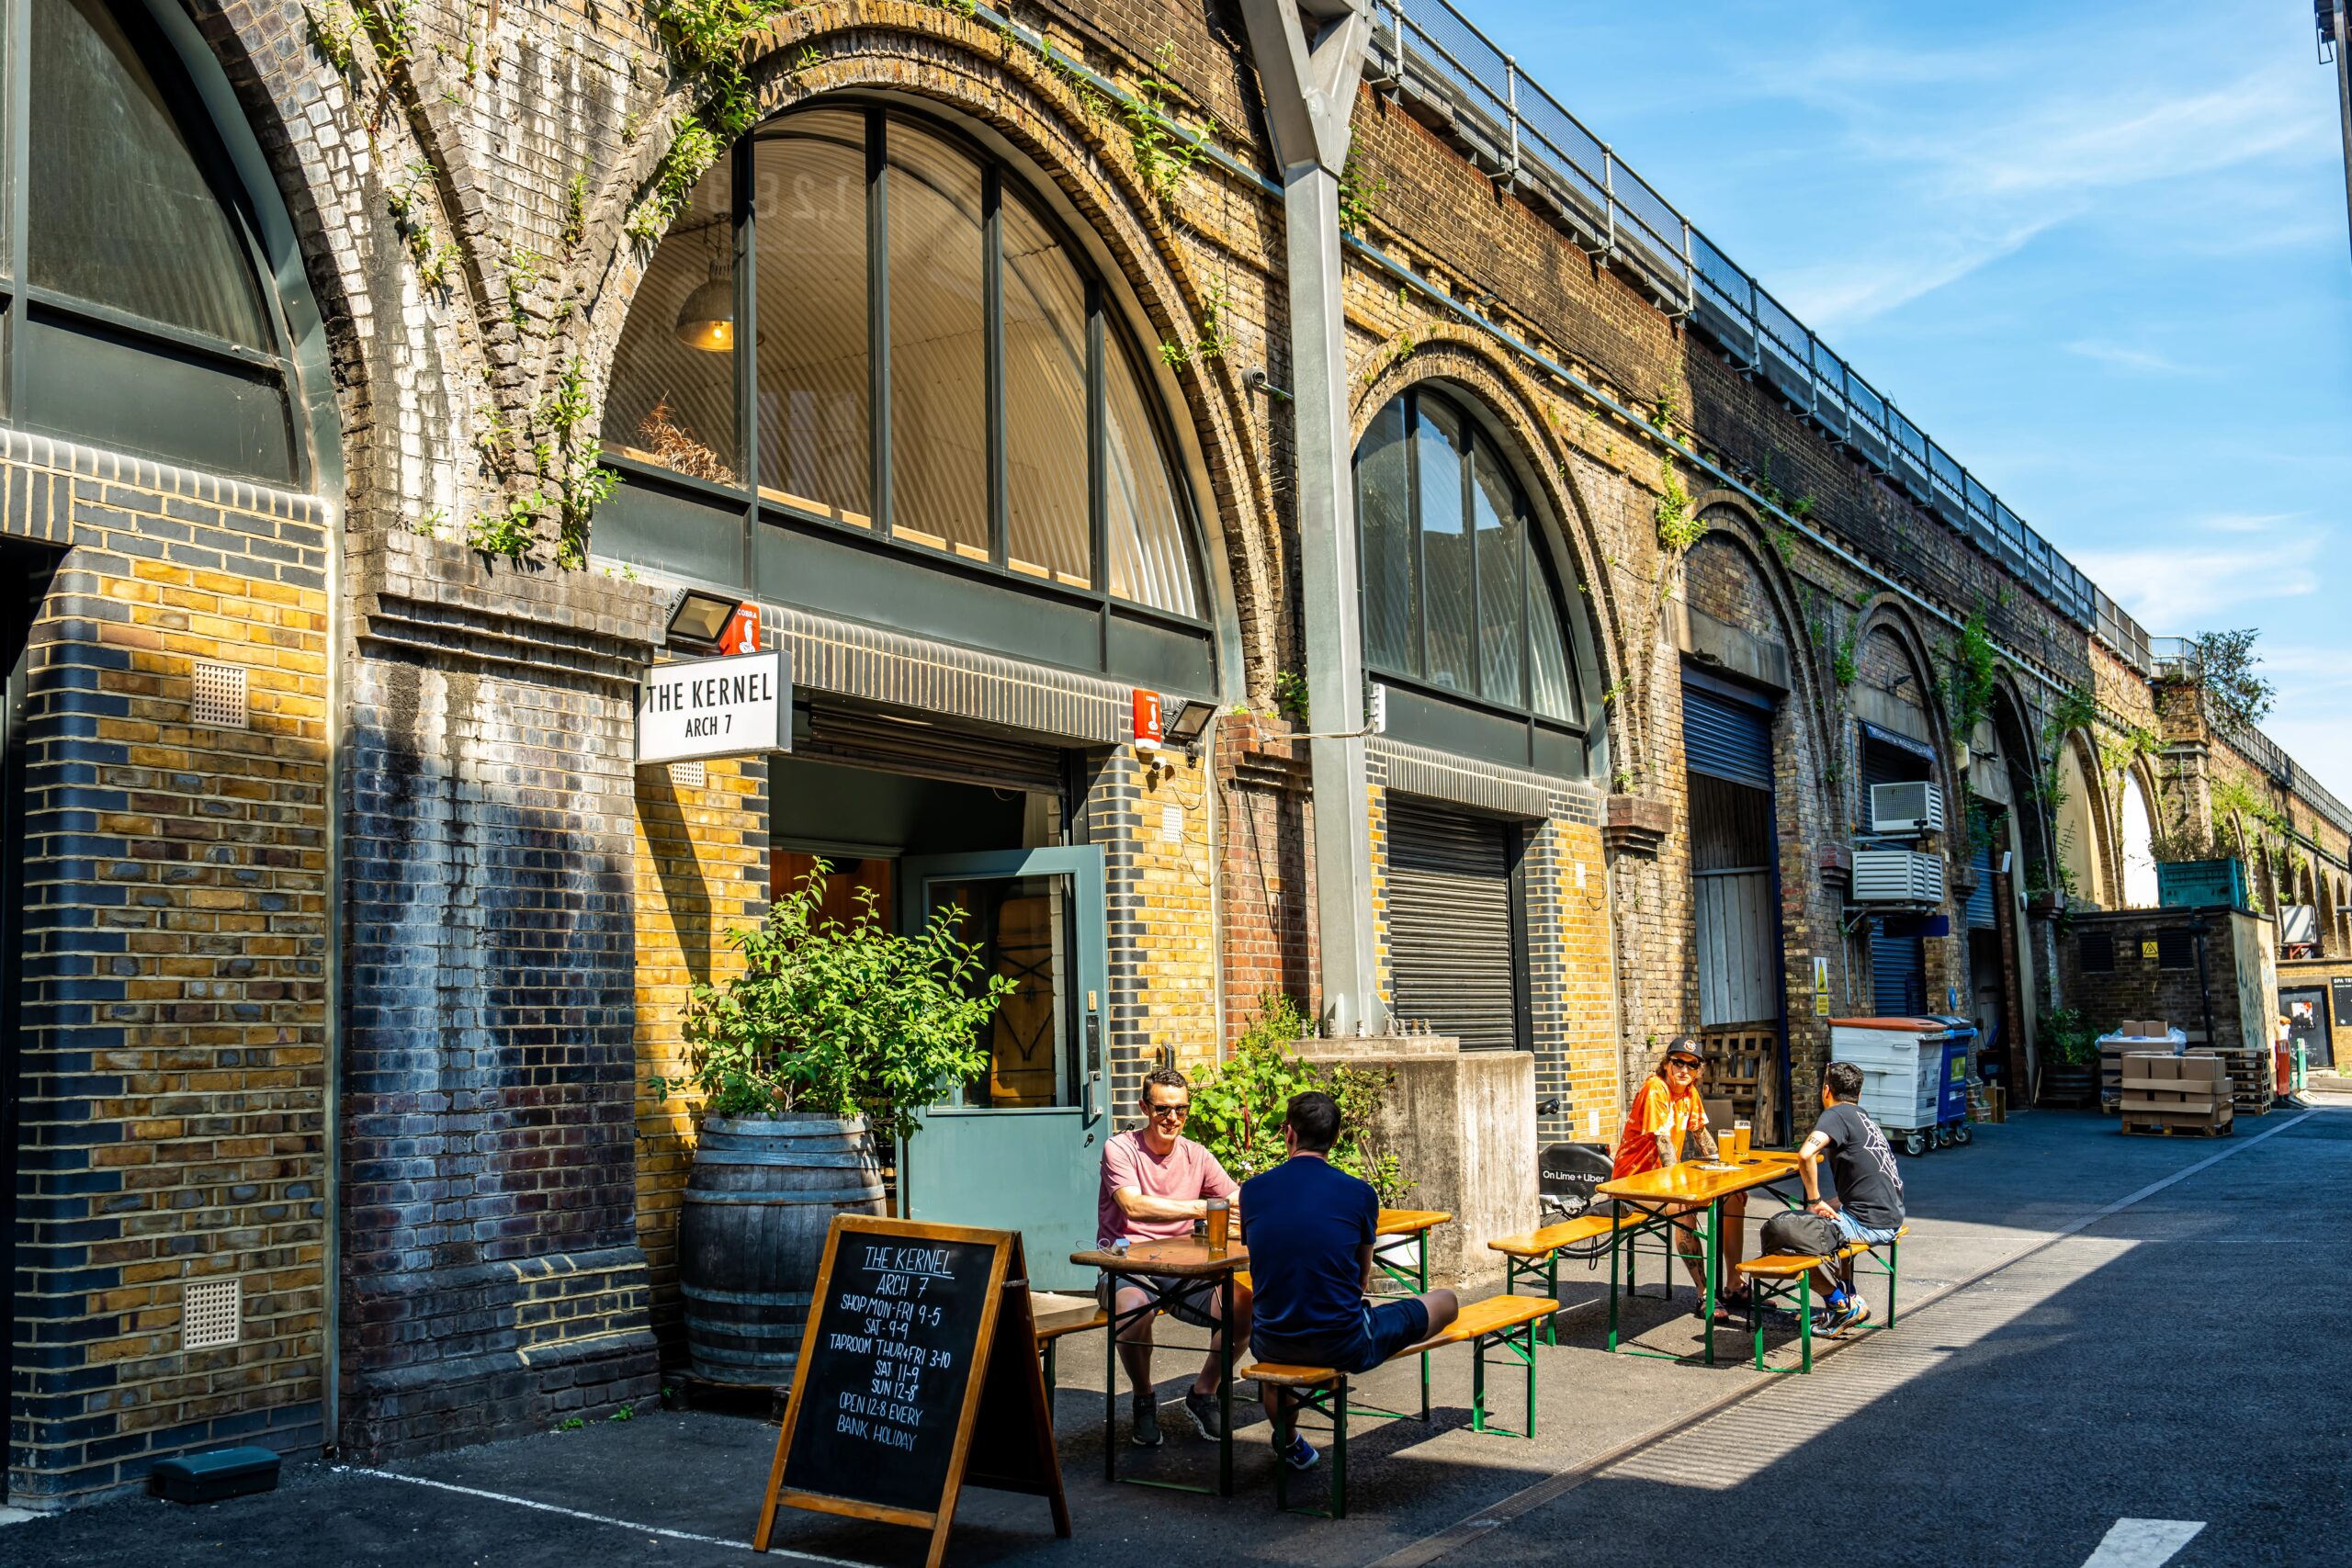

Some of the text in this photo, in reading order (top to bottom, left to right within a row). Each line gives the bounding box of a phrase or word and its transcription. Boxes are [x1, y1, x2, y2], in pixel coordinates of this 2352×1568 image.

[737, 608, 758, 619] COBRA
[646, 672, 773, 713] THE KERNEL
[684, 714, 732, 738] ARCH 7
[1543, 1170, 1555, 1179] On
[1555, 1171, 1576, 1180] Lime
[1583, 1174, 1605, 1182] Uber
[865, 1247, 952, 1274] THE KERNEL
[876, 1273, 929, 1298] ARCH 7
[841, 1294, 866, 1313] SHOP
[831, 1333, 872, 1354] TAPROOM
[930, 1349, 951, 1369] 3-10
[875, 1359, 919, 1383] SAT 11-9
[871, 1378, 892, 1396] SUN
[839, 1392, 923, 1427] OPEN 12-8 EVERY
[837, 1414, 918, 1451] BANK HOLIDAY
